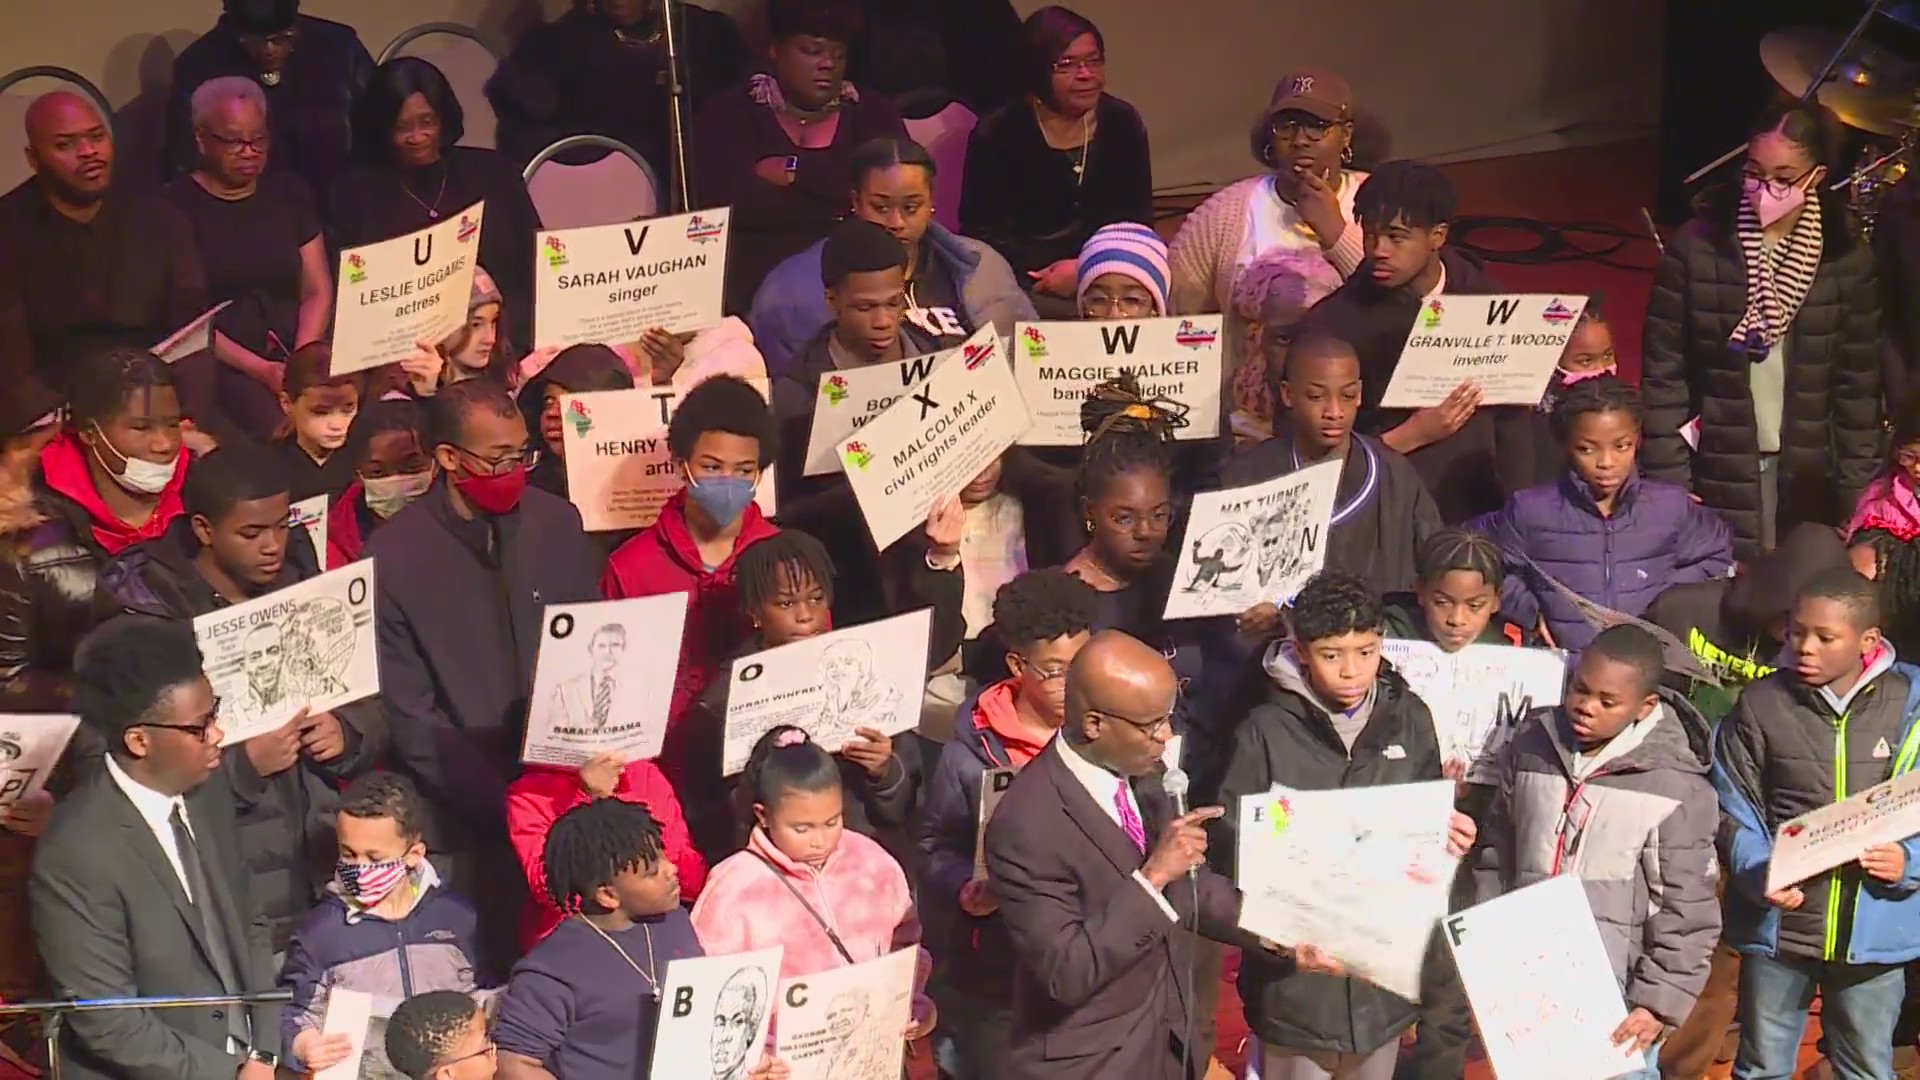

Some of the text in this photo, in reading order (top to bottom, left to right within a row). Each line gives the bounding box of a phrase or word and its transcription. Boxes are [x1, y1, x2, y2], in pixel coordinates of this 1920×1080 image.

[414, 234, 432, 266] U
[624, 226, 649, 256] V
[360, 255, 466, 306] LESLIE UGGAMS
[558, 254, 707, 289] SARAH VAUGHAN
[395, 293, 440, 317] actress
[608, 284, 658, 303] singer
[1486, 299, 1520, 326] W
[1101, 325, 1140, 355] W
[1409, 335, 1494, 348] GRANVILLE
[1510, 333, 1566, 347] WOODS
[901, 356, 935, 386] W
[1038, 361, 1199, 381] MAGGIE WALKER
[1453, 353, 1508, 367] inventor
[651, 393, 675, 425] T
[912, 384, 940, 421] X
[893, 401, 966, 468] MALCOLM
[967, 390, 978, 404] X
[596, 439, 657, 456] HENRY
[884, 470, 915, 496] civil
[918, 435, 957, 473] rights
[959, 395, 998, 436] leader
[645, 461, 675, 475] arti
[1221, 482, 1310, 513] NAT TURNER
[1300, 524, 1319, 553] N
[348, 577, 366, 605] O
[206, 615, 246, 640] JESSE
[250, 599, 298, 626] OWENS
[550, 612, 574, 640] O
[739, 663, 763, 681] O
[729, 684, 823, 712] OPRAH WINFREY
[1495, 691, 1533, 728] M
[553, 721, 641, 735] BARACK OBAMA
[994, 771, 1014, 792] D
[1448, 916, 1467, 947] F
[672, 985, 694, 1018] B
[786, 983, 809, 1008] C
